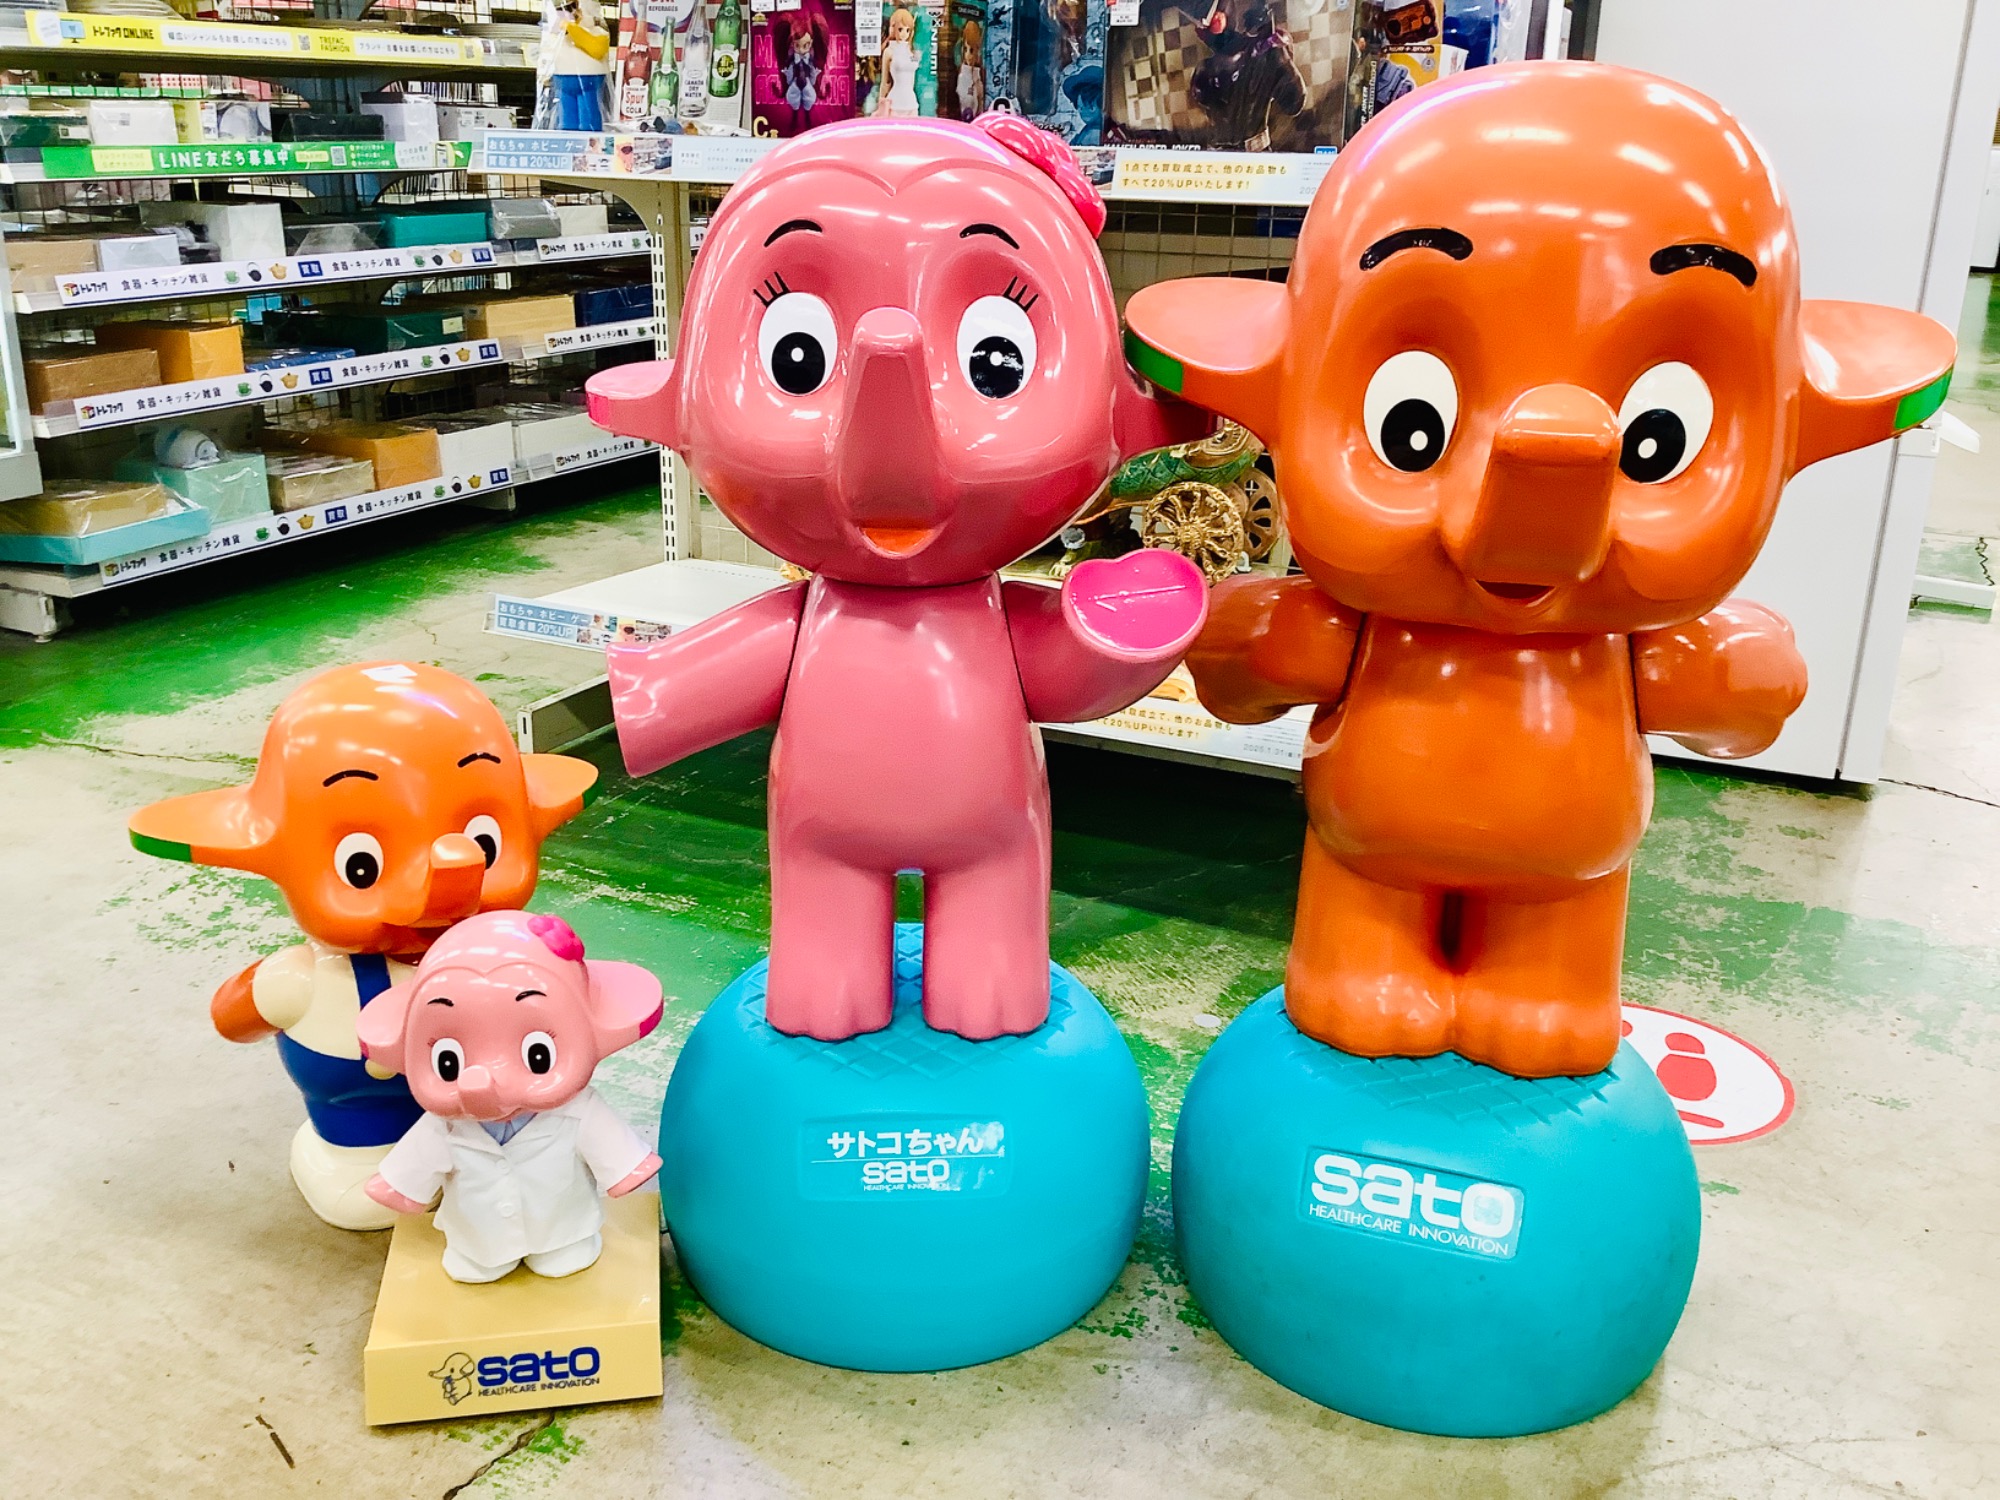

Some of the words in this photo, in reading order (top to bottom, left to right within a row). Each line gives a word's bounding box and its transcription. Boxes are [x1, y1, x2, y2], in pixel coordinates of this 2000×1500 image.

[625, 91, 645, 105] Spur
[625, 106, 642, 114] COLA
[488, 139, 525, 151] おもちゃ
[531, 140, 559, 152] ホビー
[331, 256, 401, 273] 食器・キッチン雑貨
[473, 249, 491, 262] 買取
[299, 261, 322, 277] 買取
[120, 272, 210, 292] 食器・キッチン雑貨
[481, 345, 497, 359] 買取
[311, 369, 332, 384] 買取
[342, 358, 410, 377] 食器・キッチン雑貨
[136, 387, 222, 411] 食器・キッチン雑貨
[491, 468, 508, 483] 買取
[356, 489, 423, 515] 食器・キッチン雑貨
[327, 506, 347, 523] 買取
[158, 534, 241, 564] 食器・キッチン雑貨
[499, 602, 534, 617] おもちゃ
[538, 609, 566, 621] ホビー
[1120, 707, 1233, 731] 取成立で、他のお品物も
[826, 1126, 986, 1160] サトコちゃん
[862, 1159, 950, 1186] sato
[862, 1183, 905, 1192] HEALTHCARE
[1310, 1153, 1516, 1239] sato
[1308, 1202, 1403, 1235] HEALTHCARE
[1407, 1222, 1510, 1257] INNOVATION
[476, 1345, 601, 1387] sato
[477, 1382, 538, 1398] HEALTHCARE
[540, 1377, 600, 1391] INNOVATION
